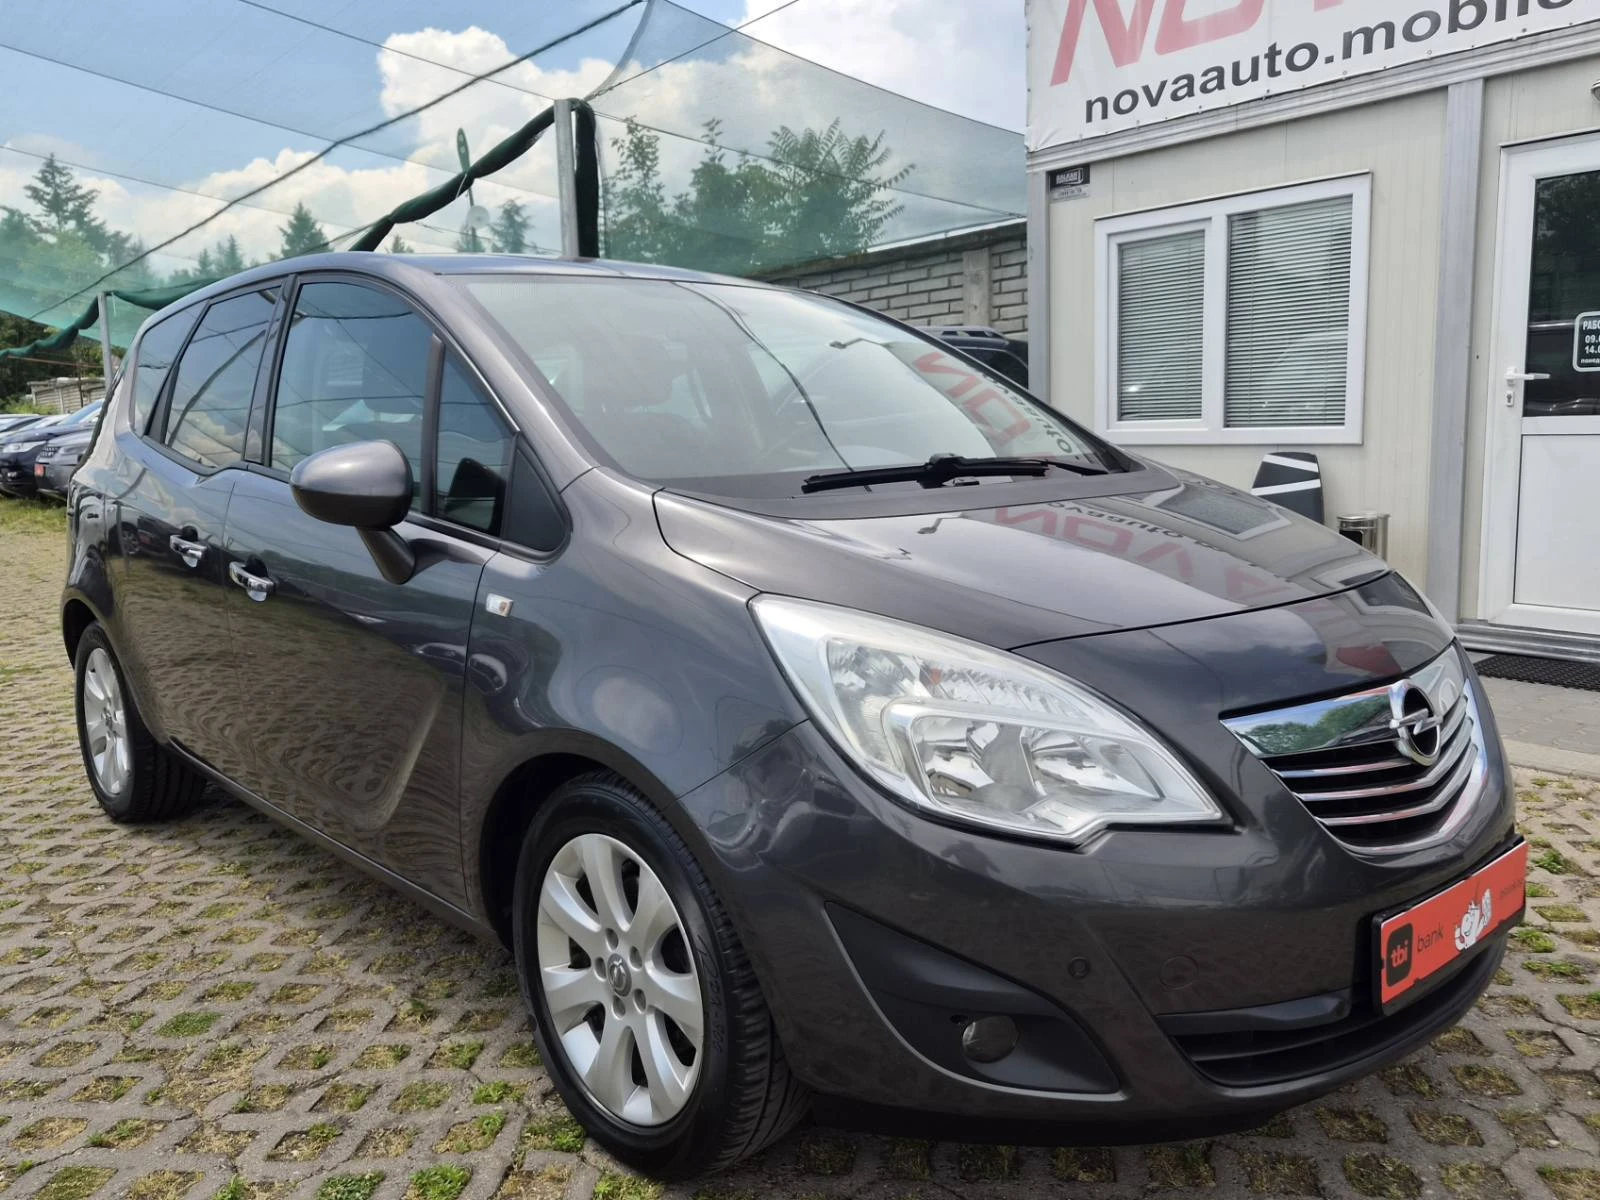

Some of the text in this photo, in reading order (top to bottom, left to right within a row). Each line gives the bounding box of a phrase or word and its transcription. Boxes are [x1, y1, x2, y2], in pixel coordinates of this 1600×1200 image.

[1585, 335, 1600, 344] 09.
[1391, 922, 1444, 968] tbi bank
